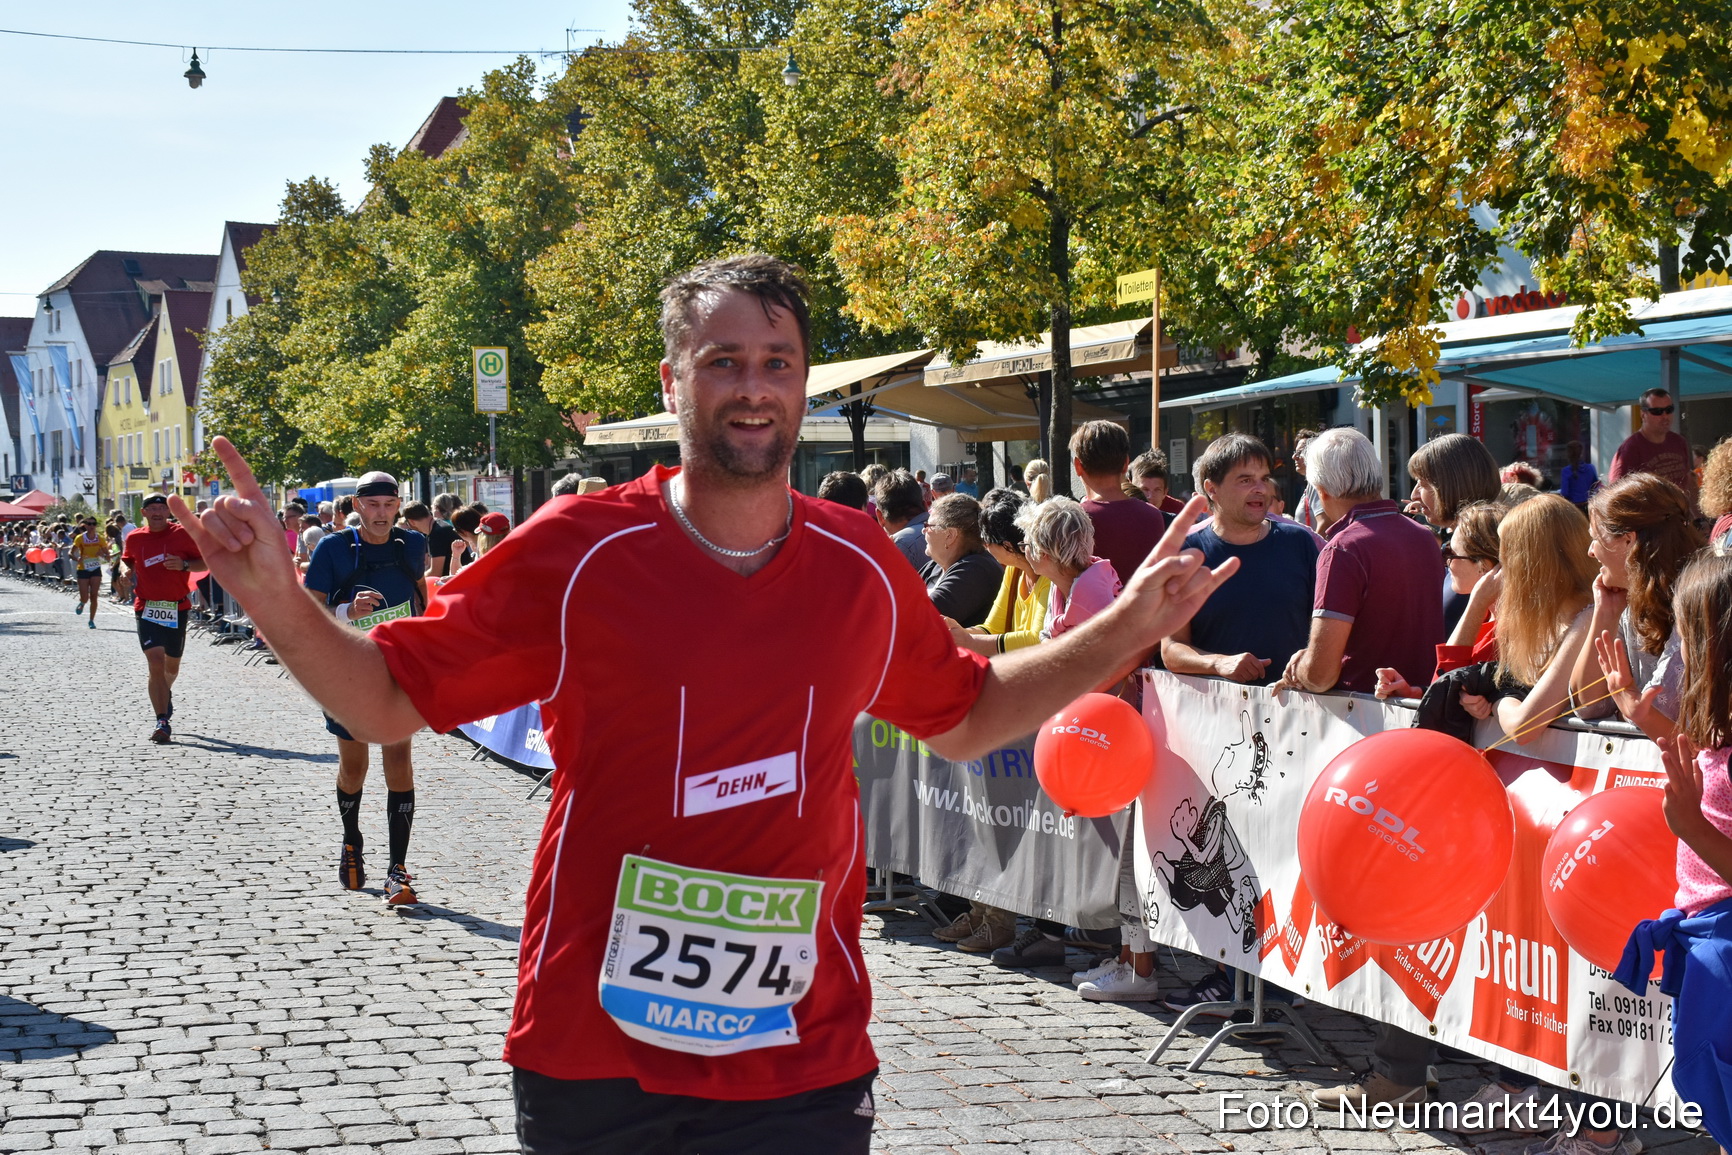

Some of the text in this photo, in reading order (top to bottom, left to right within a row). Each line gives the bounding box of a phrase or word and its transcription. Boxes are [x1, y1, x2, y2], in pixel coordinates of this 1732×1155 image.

[1123, 280, 1154, 295] Toiletten
[1472, 402, 1480, 433] Store
[146, 609, 174, 620] 3004
[359, 604, 408, 629] BOCK
[1051, 716, 1111, 746] RÖDL
[716, 771, 767, 799] DEHN
[1323, 779, 1427, 855] RÖDL
[1367, 824, 1419, 862] energie
[1551, 819, 1615, 893] RÖDL
[625, 868, 803, 925] BOCK
[629, 924, 791, 996] 2574
[1394, 948, 1416, 975] Sicher
[1412, 967, 1425, 984] ist
[1422, 979, 1444, 1002] sicher
[1474, 910, 1559, 1006] Braun
[646, 1001, 756, 1035] MARCO
[1505, 998, 1568, 1036] Sicher ist sicher
[1588, 990, 1611, 1012] Tel.
[1614, 995, 1653, 1018] 09181
[1588, 1013, 1614, 1035] Fax
[1617, 1018, 1654, 1042] 09181
